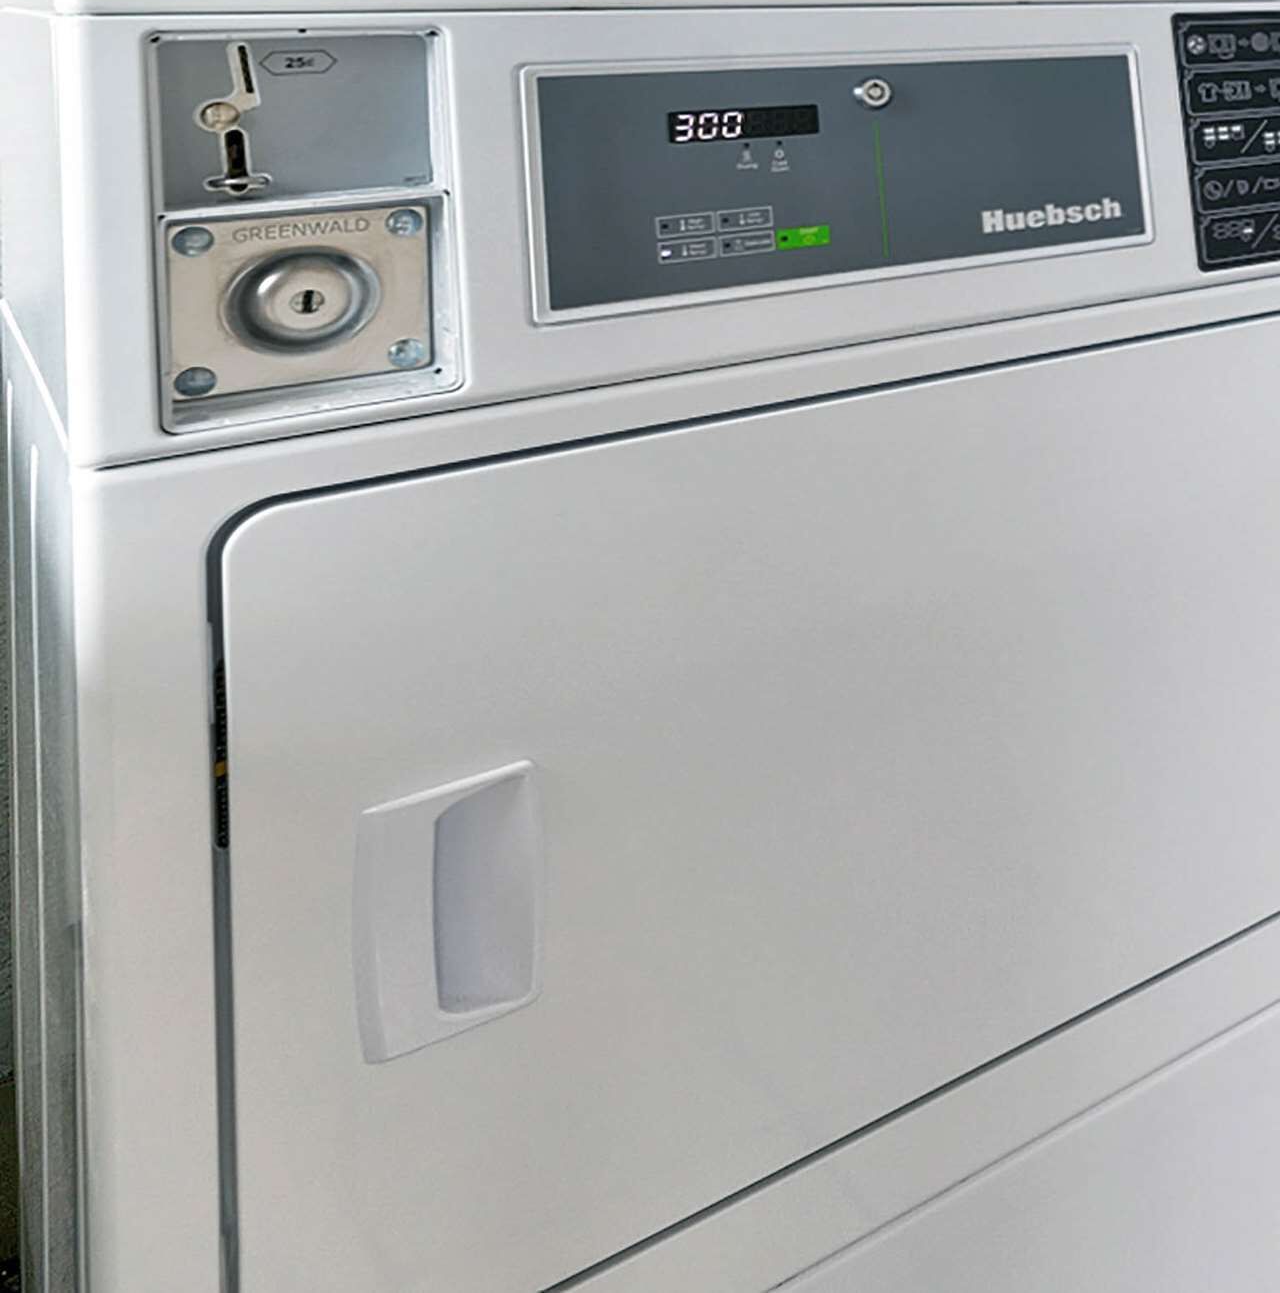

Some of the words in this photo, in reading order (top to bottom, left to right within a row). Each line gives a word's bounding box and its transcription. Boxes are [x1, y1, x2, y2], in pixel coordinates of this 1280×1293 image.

[675, 110, 742, 142] 300
[231, 217, 371, 244] GREENWALD
[981, 197, 1122, 234] Huebsch
